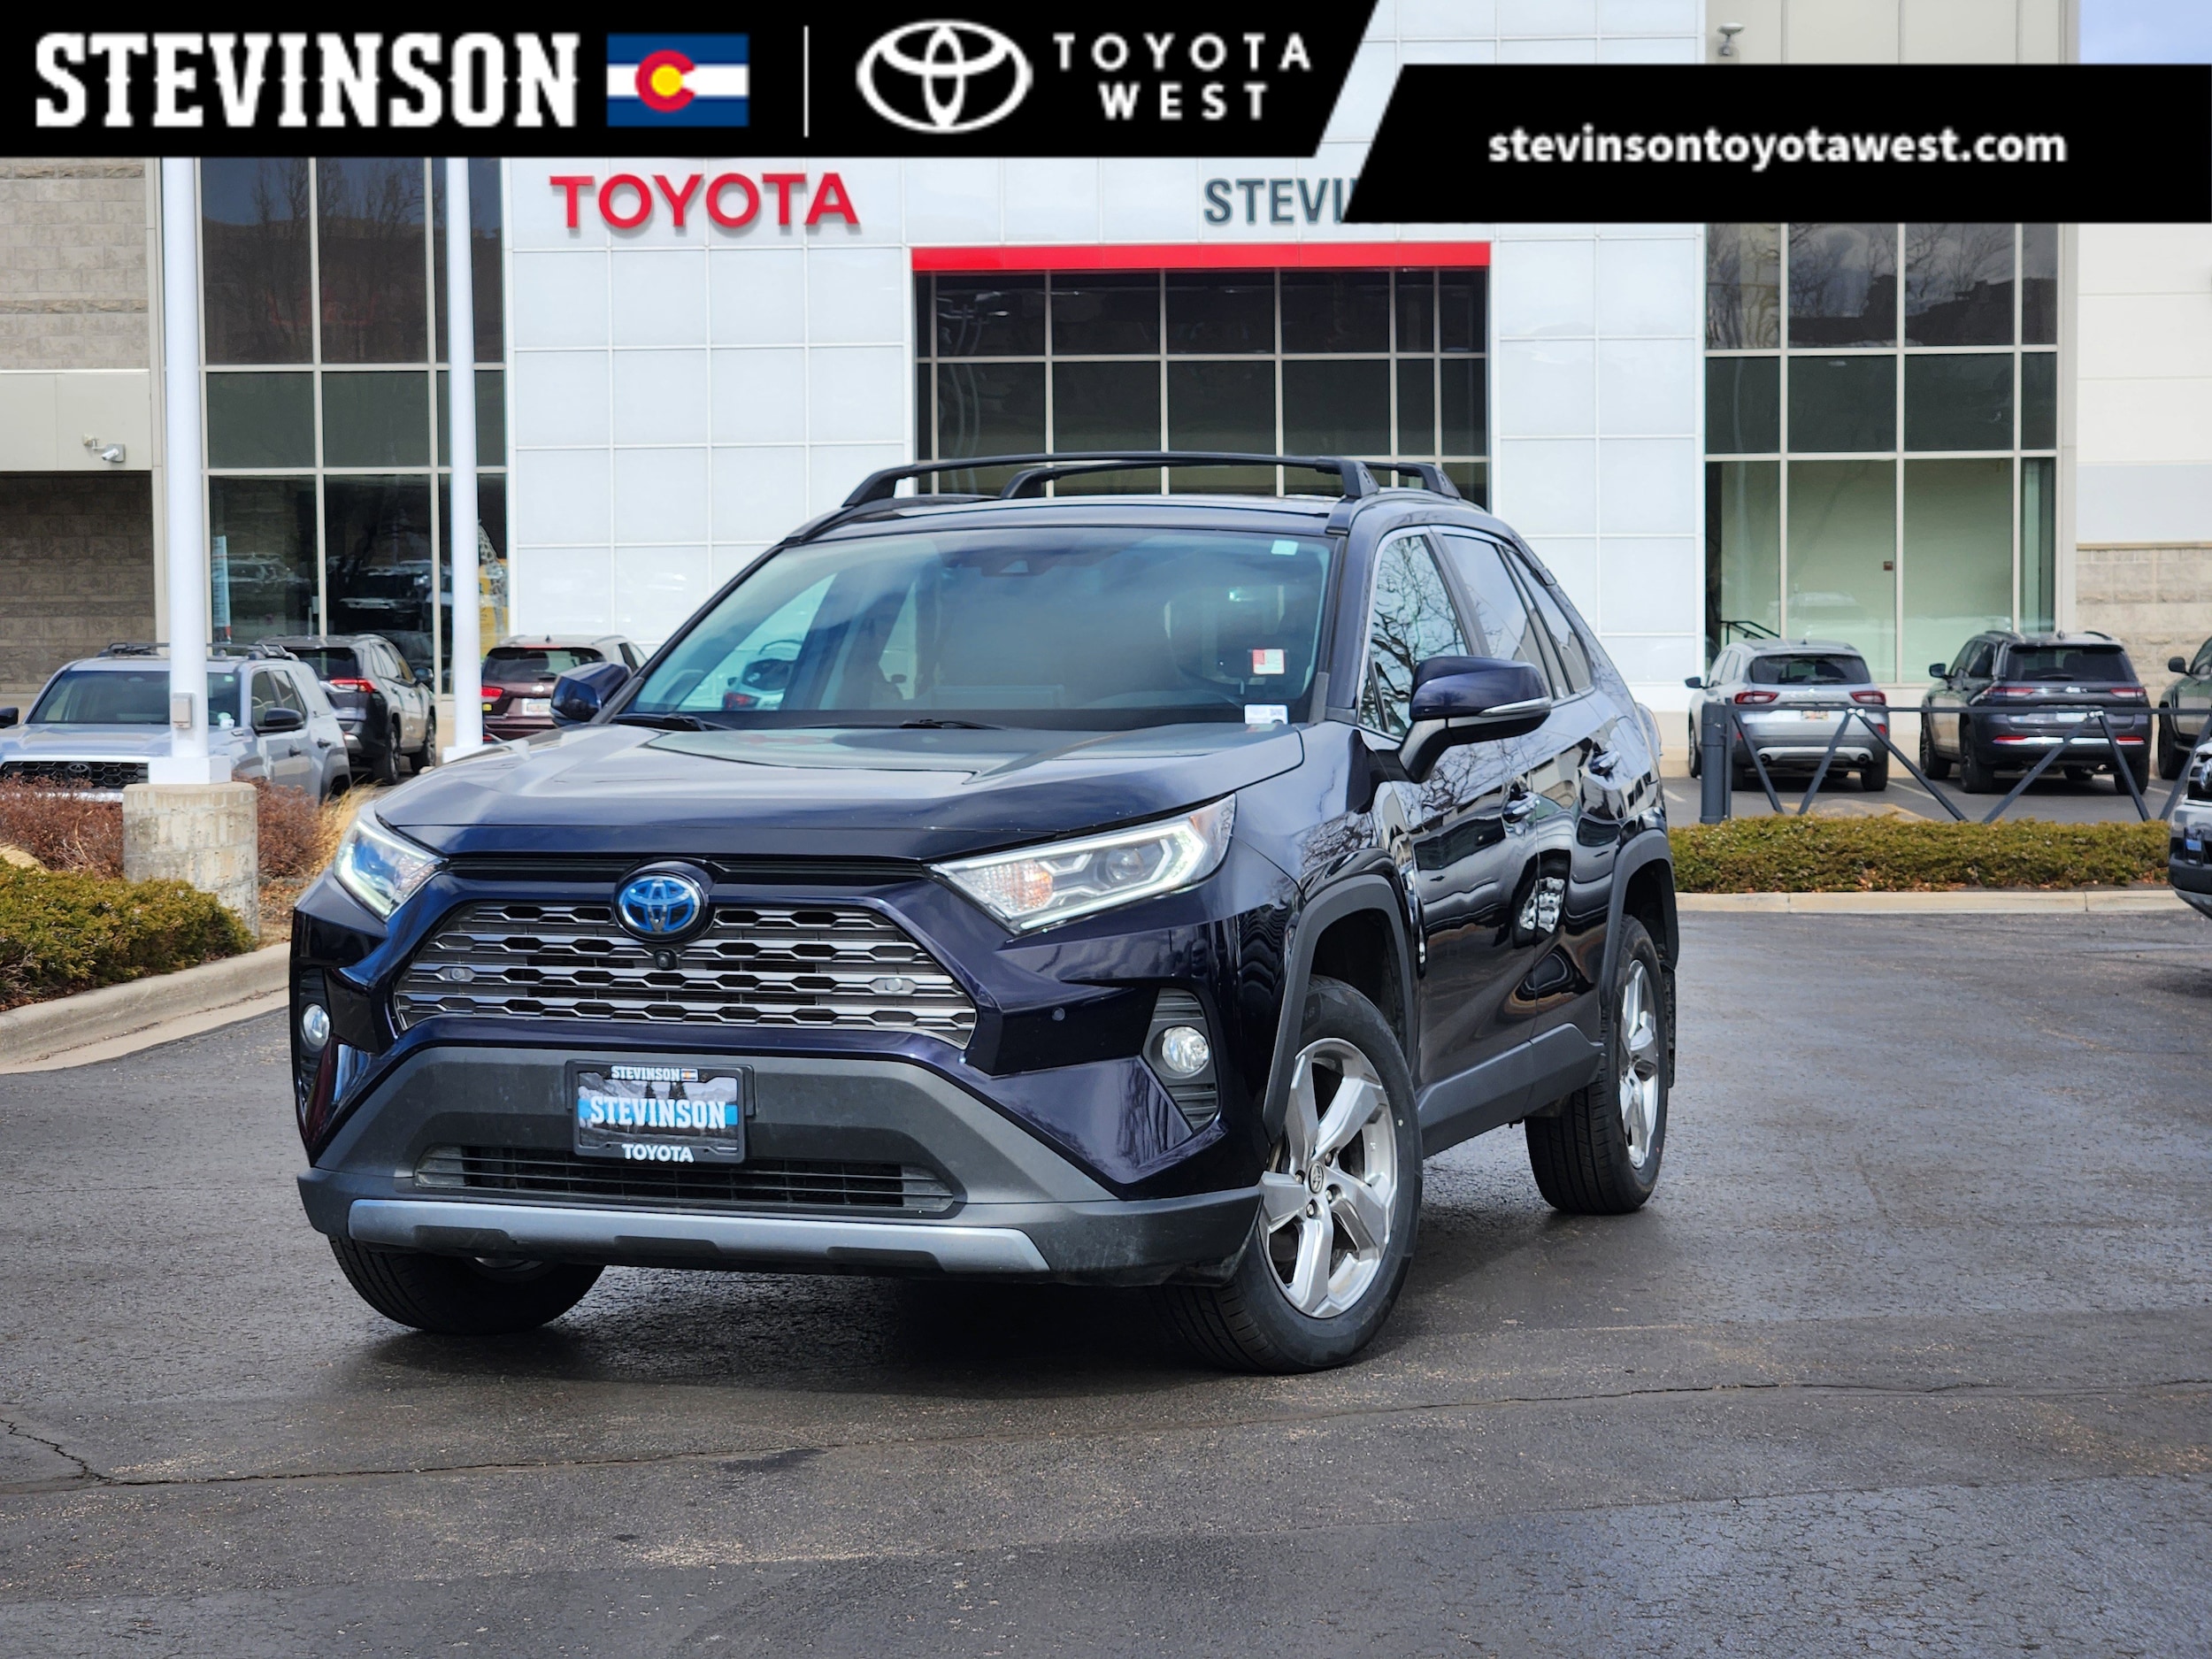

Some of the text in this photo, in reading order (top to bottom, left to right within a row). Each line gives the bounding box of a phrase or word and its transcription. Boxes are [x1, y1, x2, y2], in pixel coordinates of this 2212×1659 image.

[549, 173, 861, 229] TOYOTA
[1203, 178, 1363, 225] STEVI
[611, 1065, 681, 1081] STEVINSON
[590, 1095, 727, 1129] STEVINSON
[621, 1144, 695, 1164] TOYOTA
